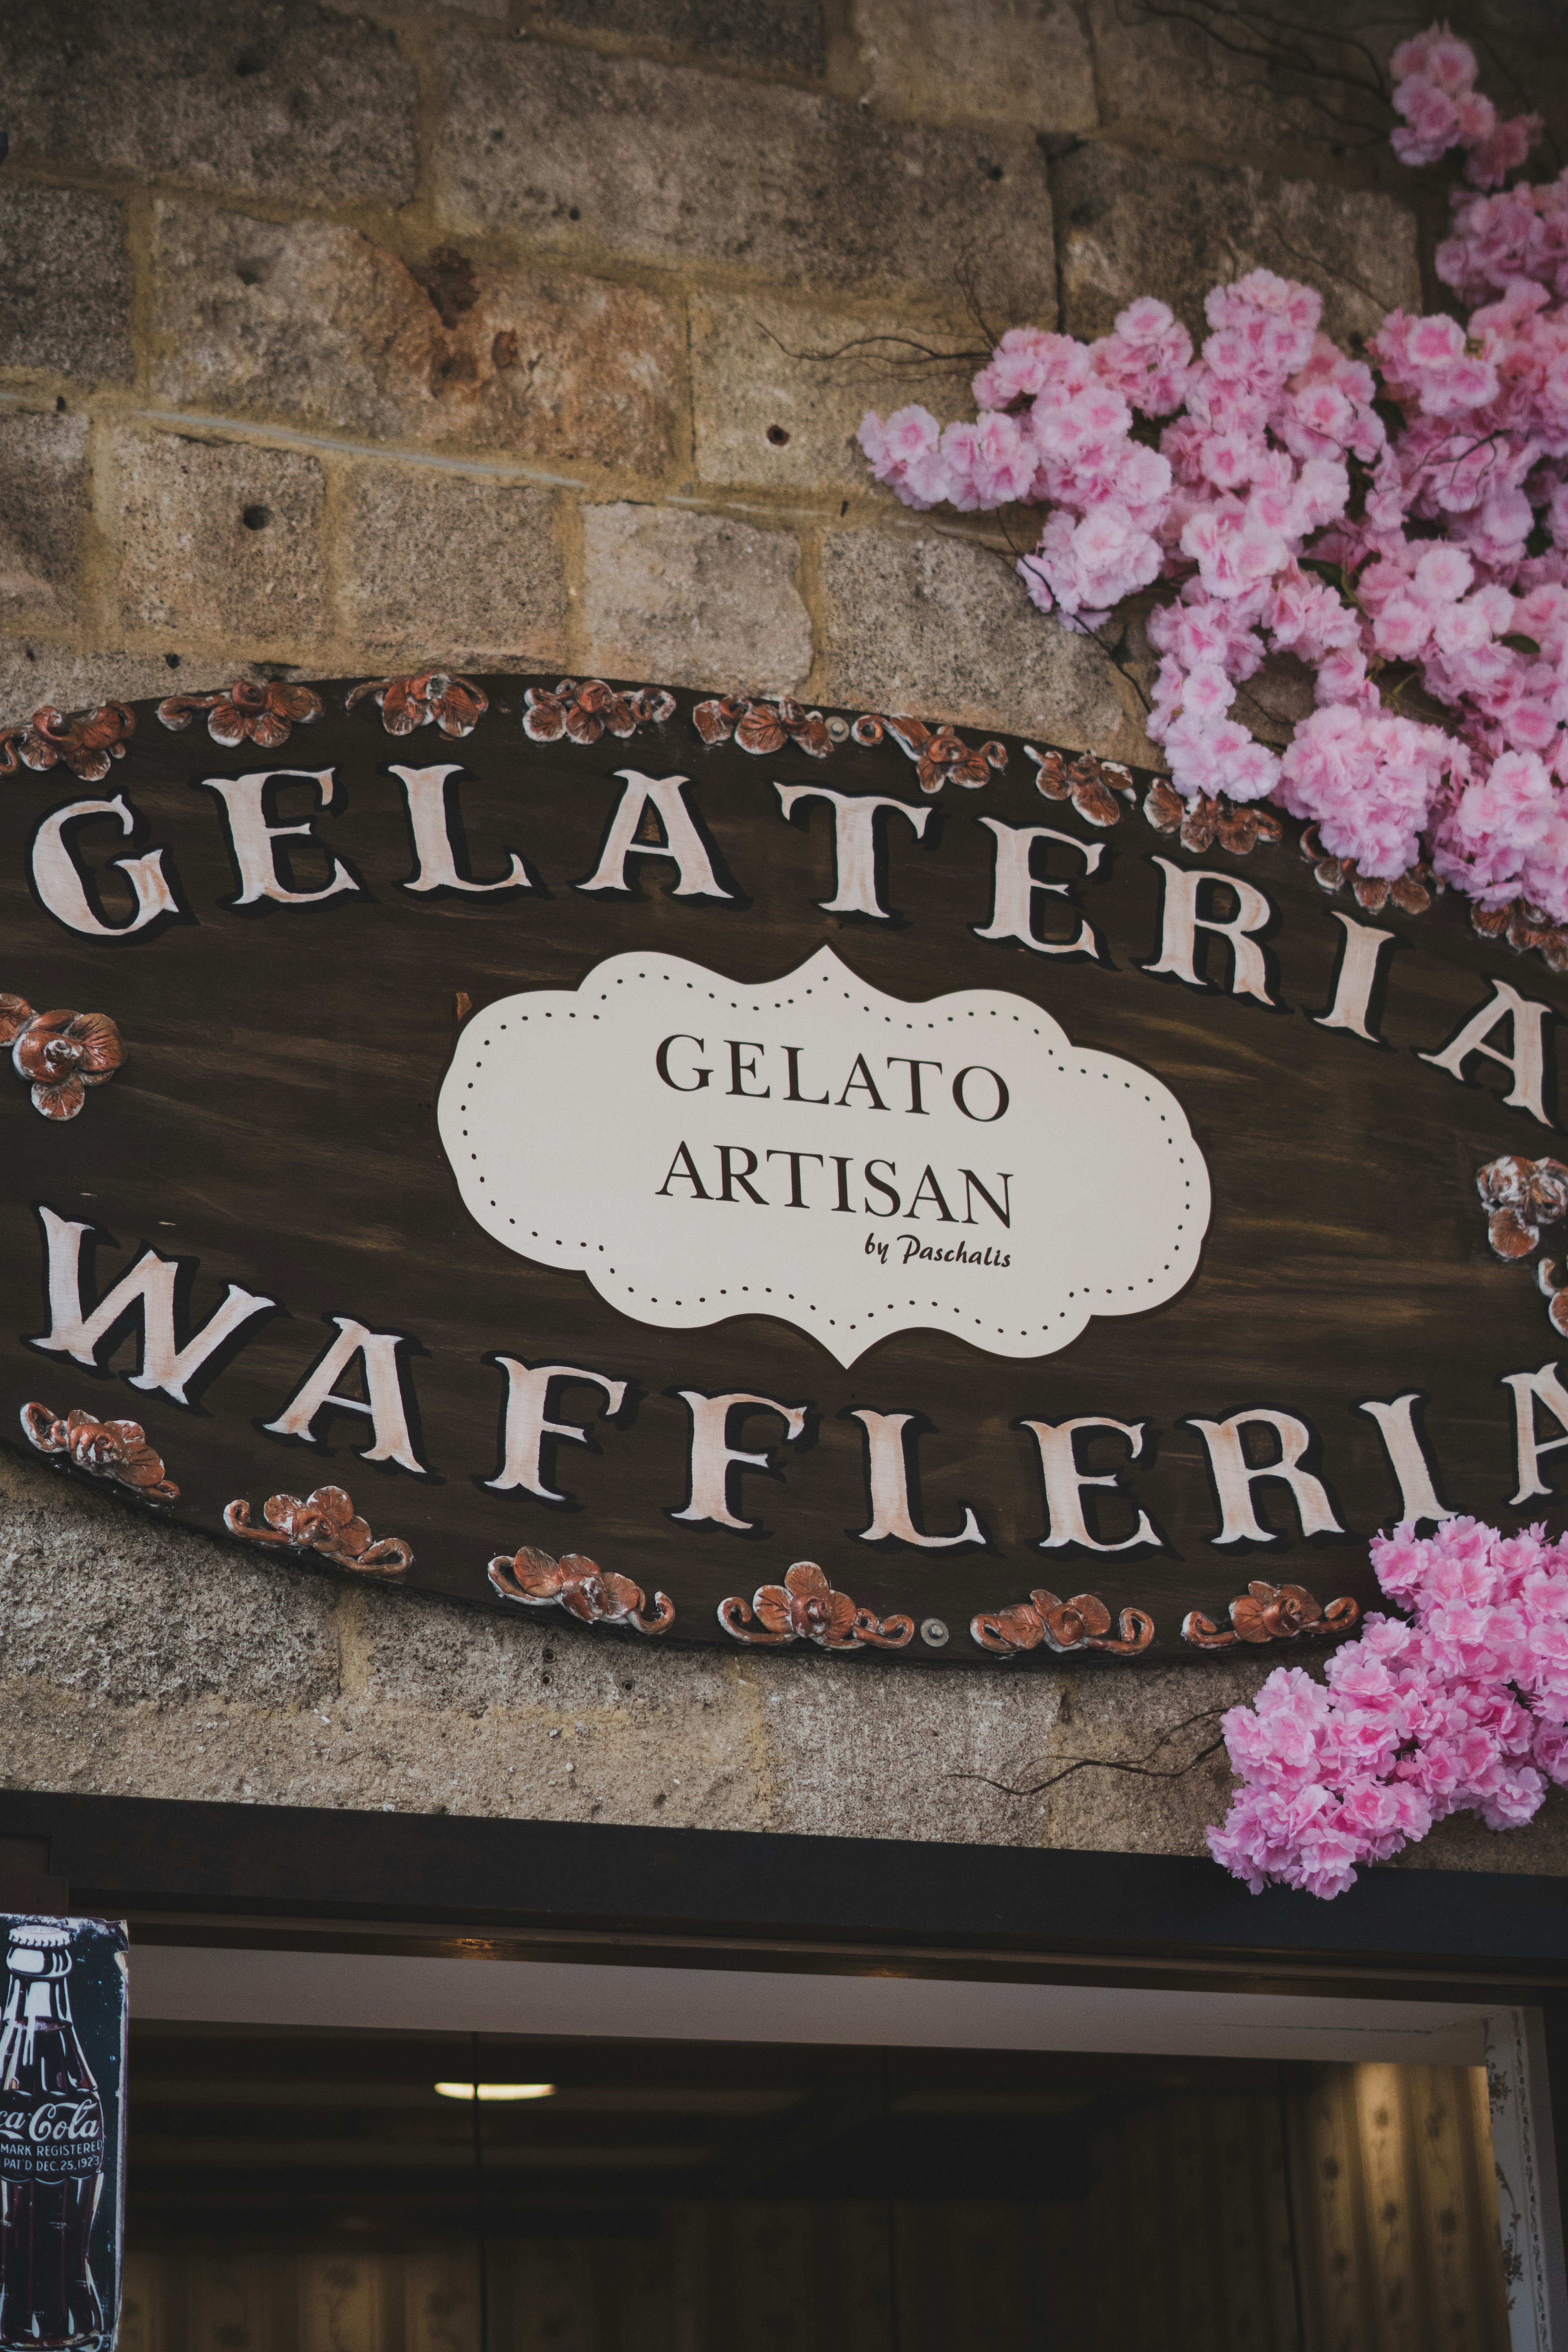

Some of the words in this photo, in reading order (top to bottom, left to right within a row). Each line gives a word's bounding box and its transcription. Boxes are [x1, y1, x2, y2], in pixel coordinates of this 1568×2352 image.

[32, 764, 1554, 1128] GELATERIA
[655, 1034, 1010, 1123] GELATO
[654, 1140, 1014, 1229] ARTISAN
[864, 1232, 889, 1265] by
[896, 1234, 1011, 1268] Paschalis
[31, 1205, 1568, 1552] WAFFLERIA
[36, 2139, 103, 2156] REGISTERED
[36, 2161, 59, 2171] DEC.
[78, 2155, 100, 2168] 1923
